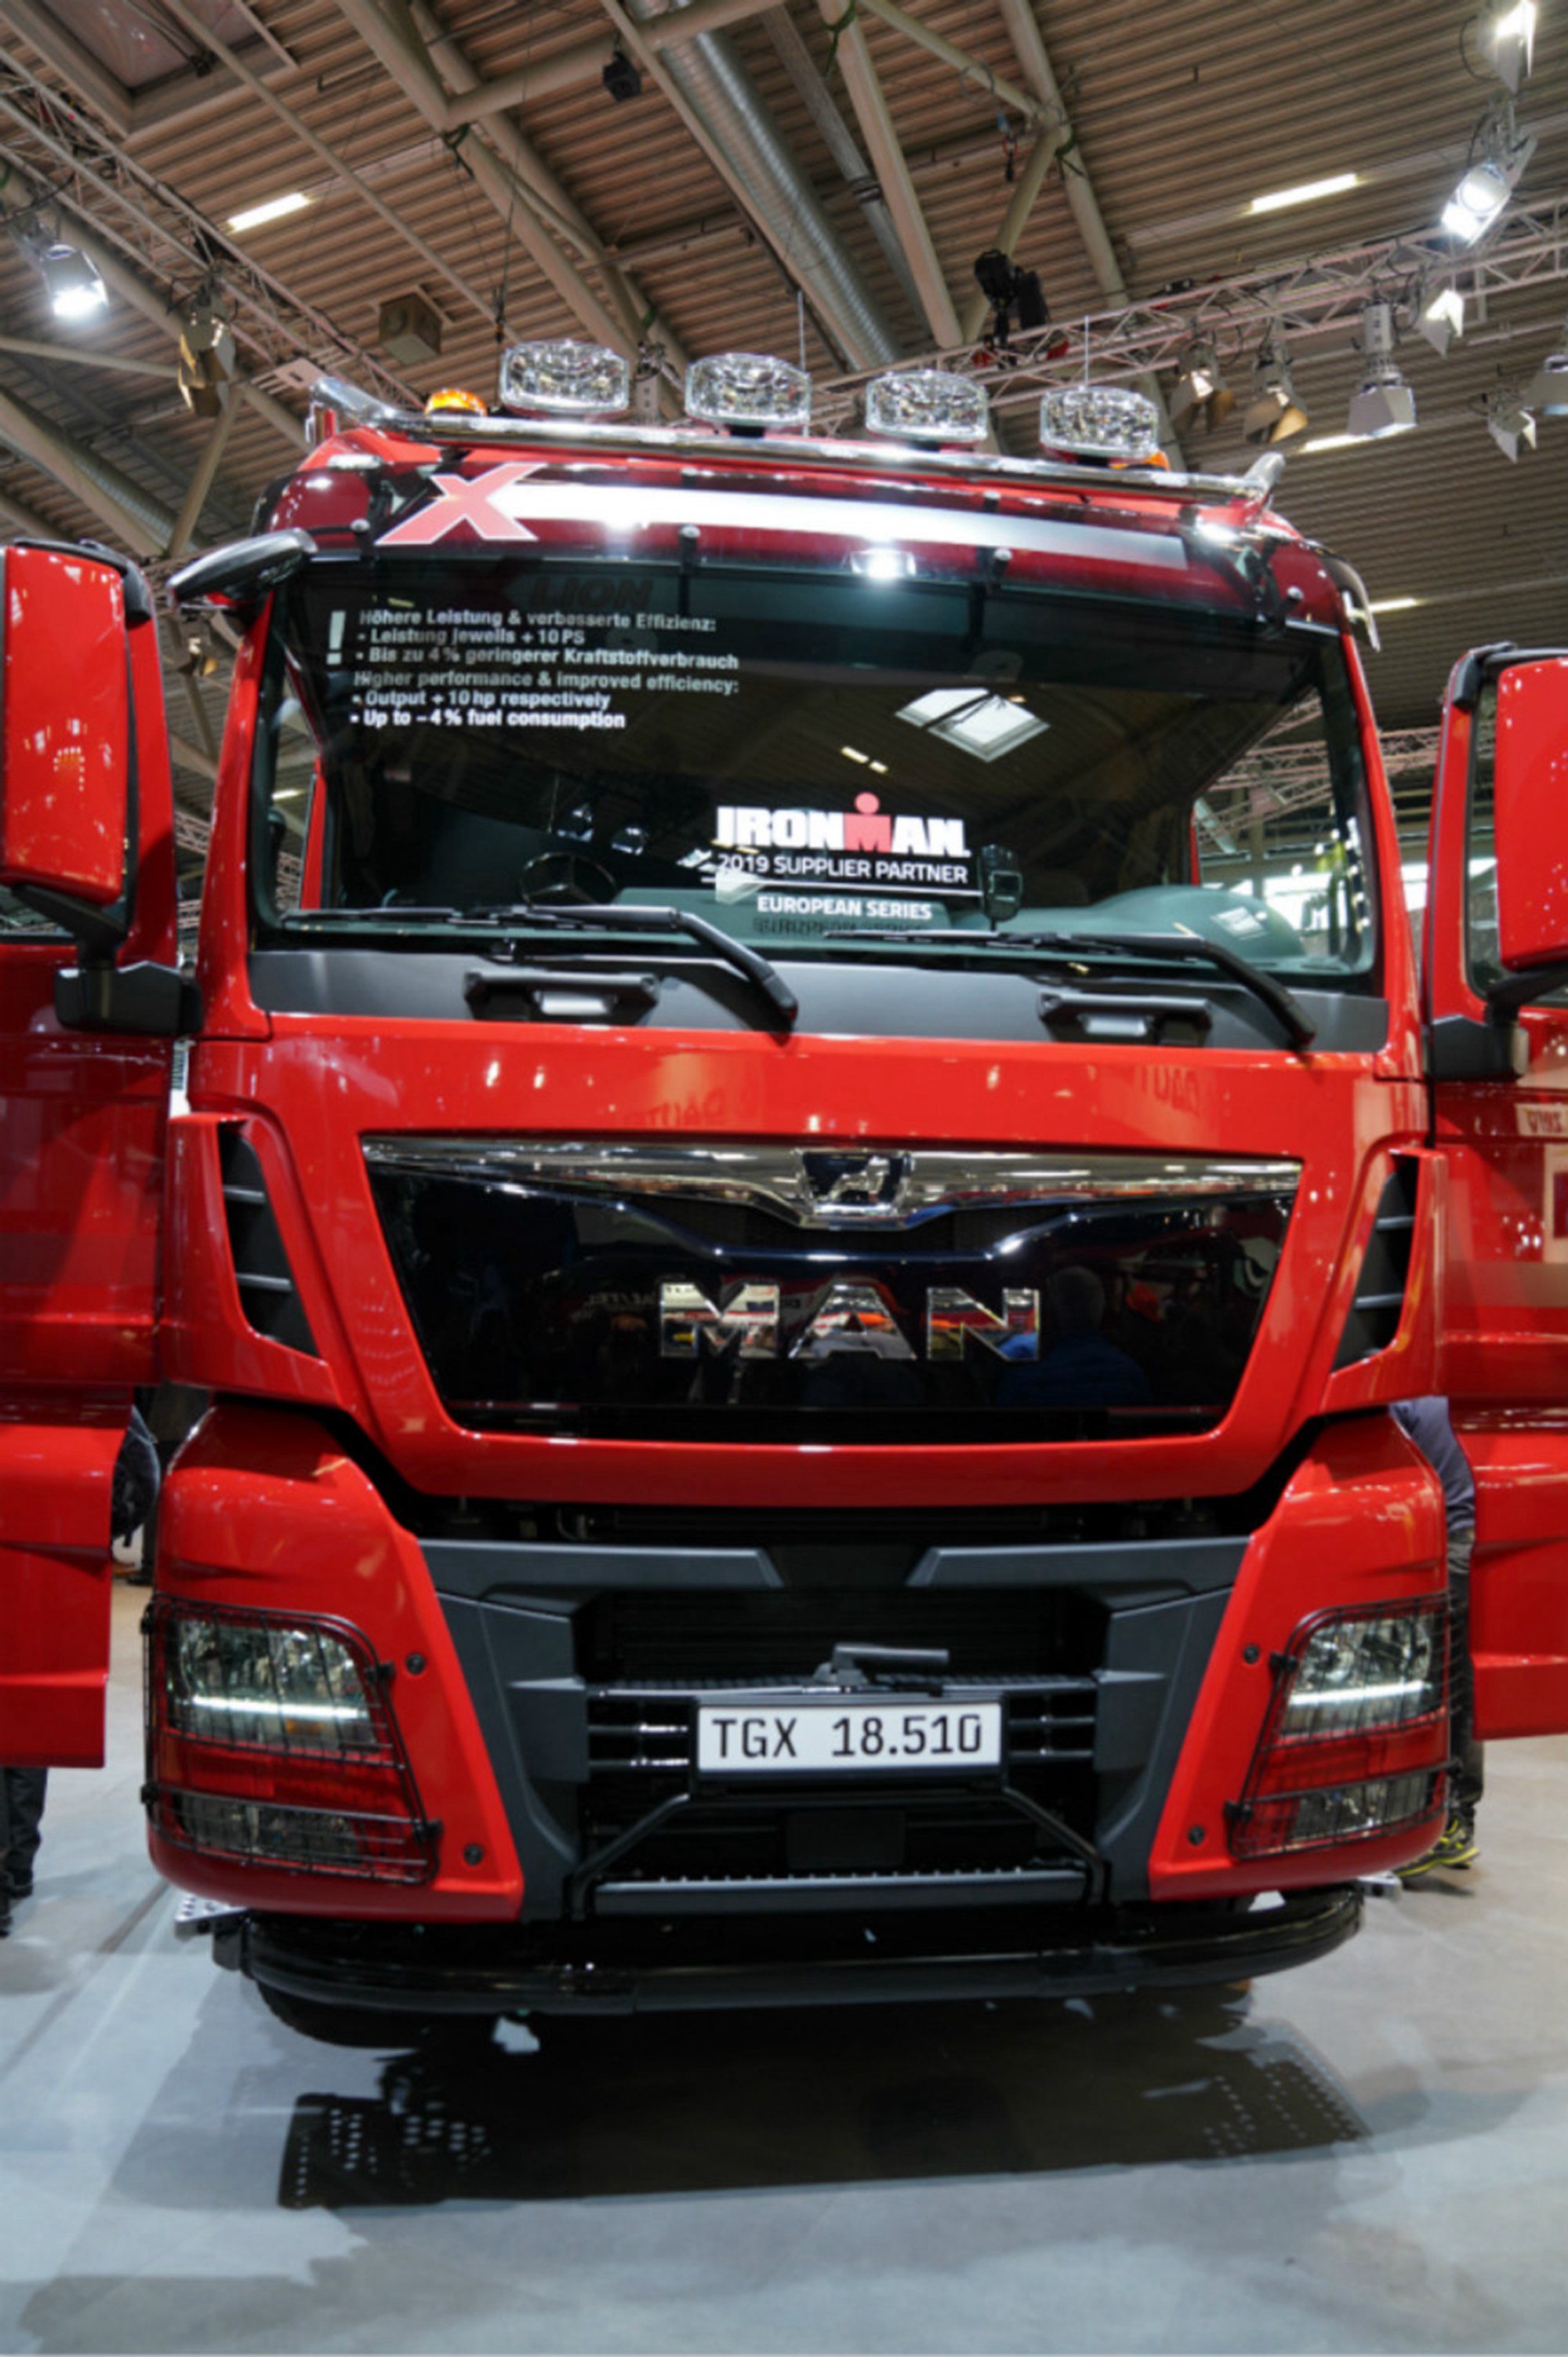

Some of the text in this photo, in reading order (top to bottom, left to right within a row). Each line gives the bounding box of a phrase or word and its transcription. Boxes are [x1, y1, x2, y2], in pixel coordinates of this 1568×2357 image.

[360, 609, 717, 632] Höhere Leistung & verbesserte Effizienz:
[371, 628, 447, 645] Leistung
[452, 629, 515, 645] jeweils
[368, 647, 396, 662] Bis
[403, 650, 423, 662] zu
[465, 648, 558, 665] geringerer
[564, 648, 739, 670] Kraftstoffverbrauch
[354, 670, 739, 696] Higher performance & improved efficiency:
[365, 690, 426, 709] Output
[500, 691, 611, 710] respectively
[364, 709, 387, 728] Up
[394, 710, 411, 725] to
[467, 710, 503, 725] fuel
[507, 712, 626, 729] consumption
[719, 853, 968, 884] 2019 SUPPLIER PARTNER
[757, 895, 932, 921] EUROPEAN SERIES
[659, 1282, 1040, 1360] MAN
[712, 1714, 982, 1759] TGX 18.510
